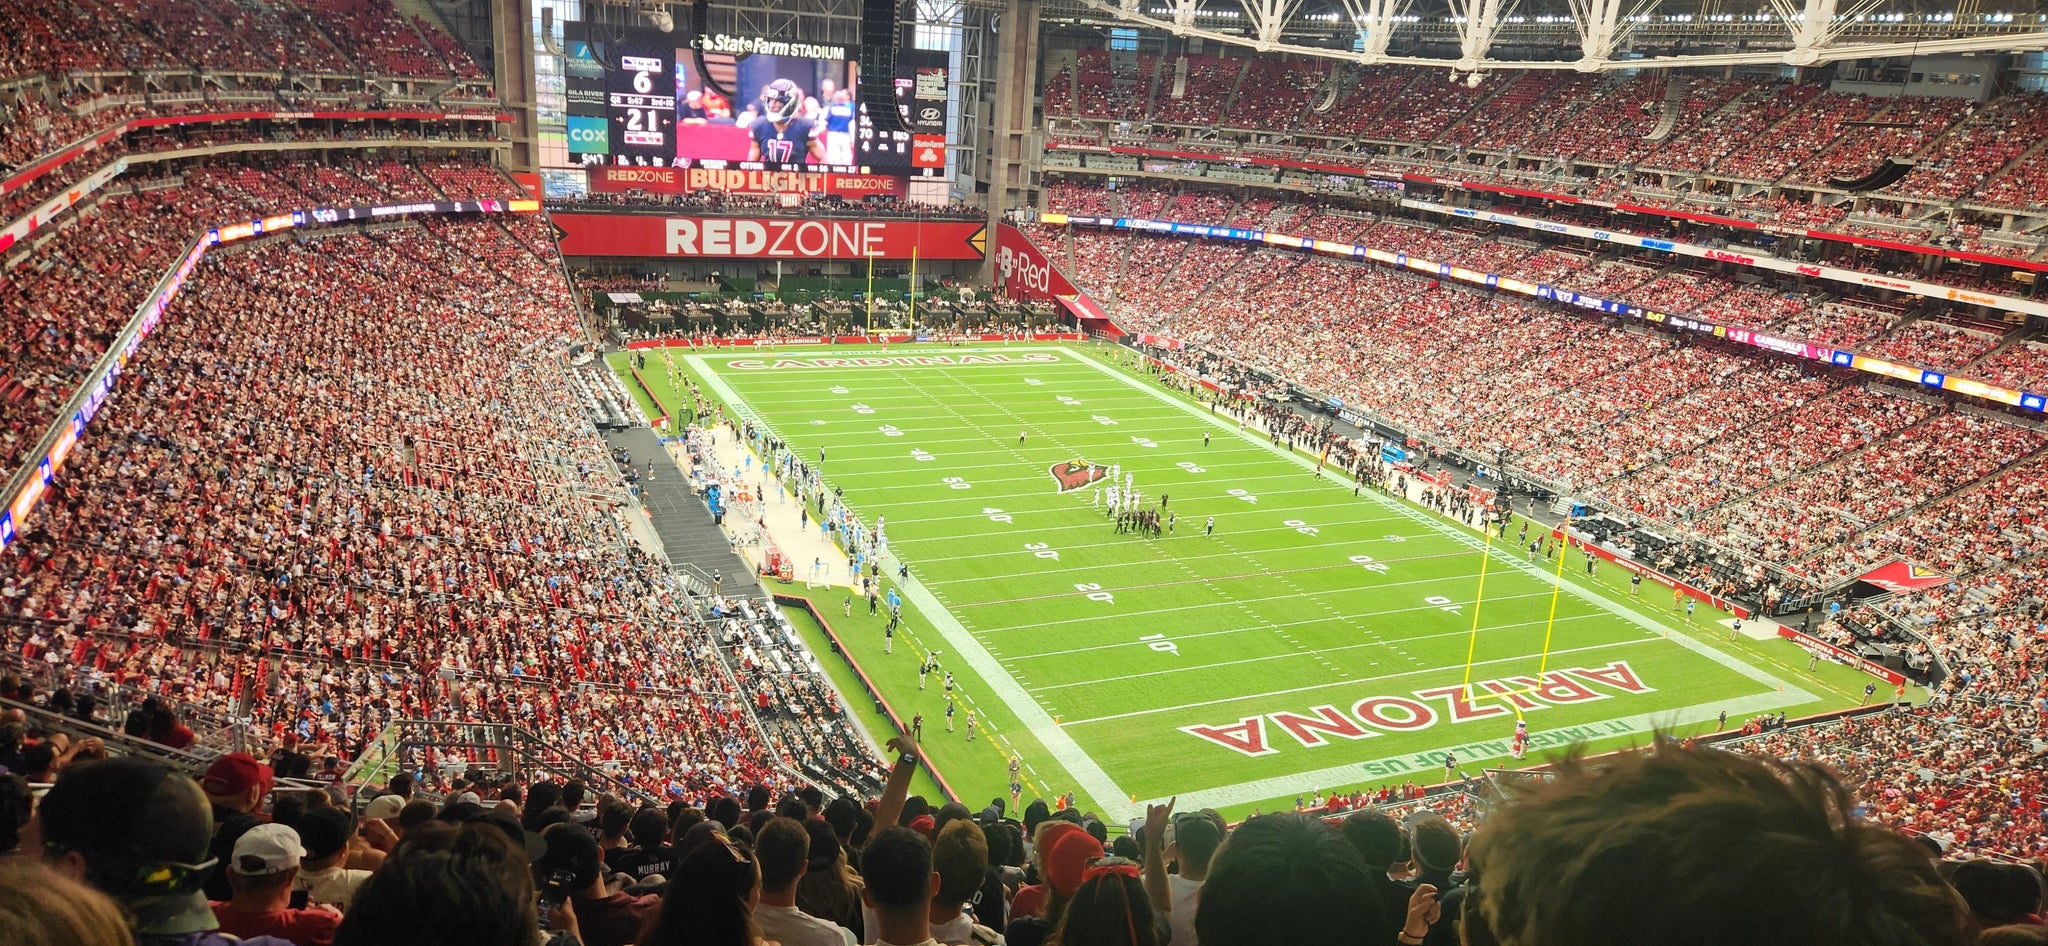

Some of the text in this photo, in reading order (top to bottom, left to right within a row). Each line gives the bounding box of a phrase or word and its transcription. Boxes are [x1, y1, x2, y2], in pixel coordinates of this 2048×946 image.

[752, 37, 789, 56] Farm
[790, 44, 844, 60] STADIUM
[633, 71, 652, 93] 6
[627, 108, 657, 132] 21
[571, 128, 606, 142] COX
[859, 128, 873, 139] 70
[767, 139, 793, 163] 17
[607, 169, 674, 183] REDZONE
[691, 168, 821, 192] BUD LIGHT
[836, 178, 894, 190] REDZONE
[665, 218, 886, 257] REDZONE
[1593, 231, 1610, 240] COX
[1759, 224, 1808, 236] LARRY WILSON
[1018, 252, 1050, 293] Red
[727, 353, 1061, 370] CARDINALS
[941, 476, 972, 489] 50
[982, 507, 1013, 522] 40
[1024, 542, 1060, 559] 30
[1613, 557, 1642, 574] ARIZONA
[1073, 582, 1114, 601] 20
[1138, 632, 1178, 652] 10
[1794, 634, 1889, 679] ARIZONA CARINALS
[1175, 659, 1659, 758] ARIZONA
[1604, 720, 1635, 734] IT
[1528, 726, 1606, 749] TAKE
[1452, 740, 1510, 758] ALL
[1363, 759, 1412, 776] US
[637, 860, 670, 876] MURRAY
